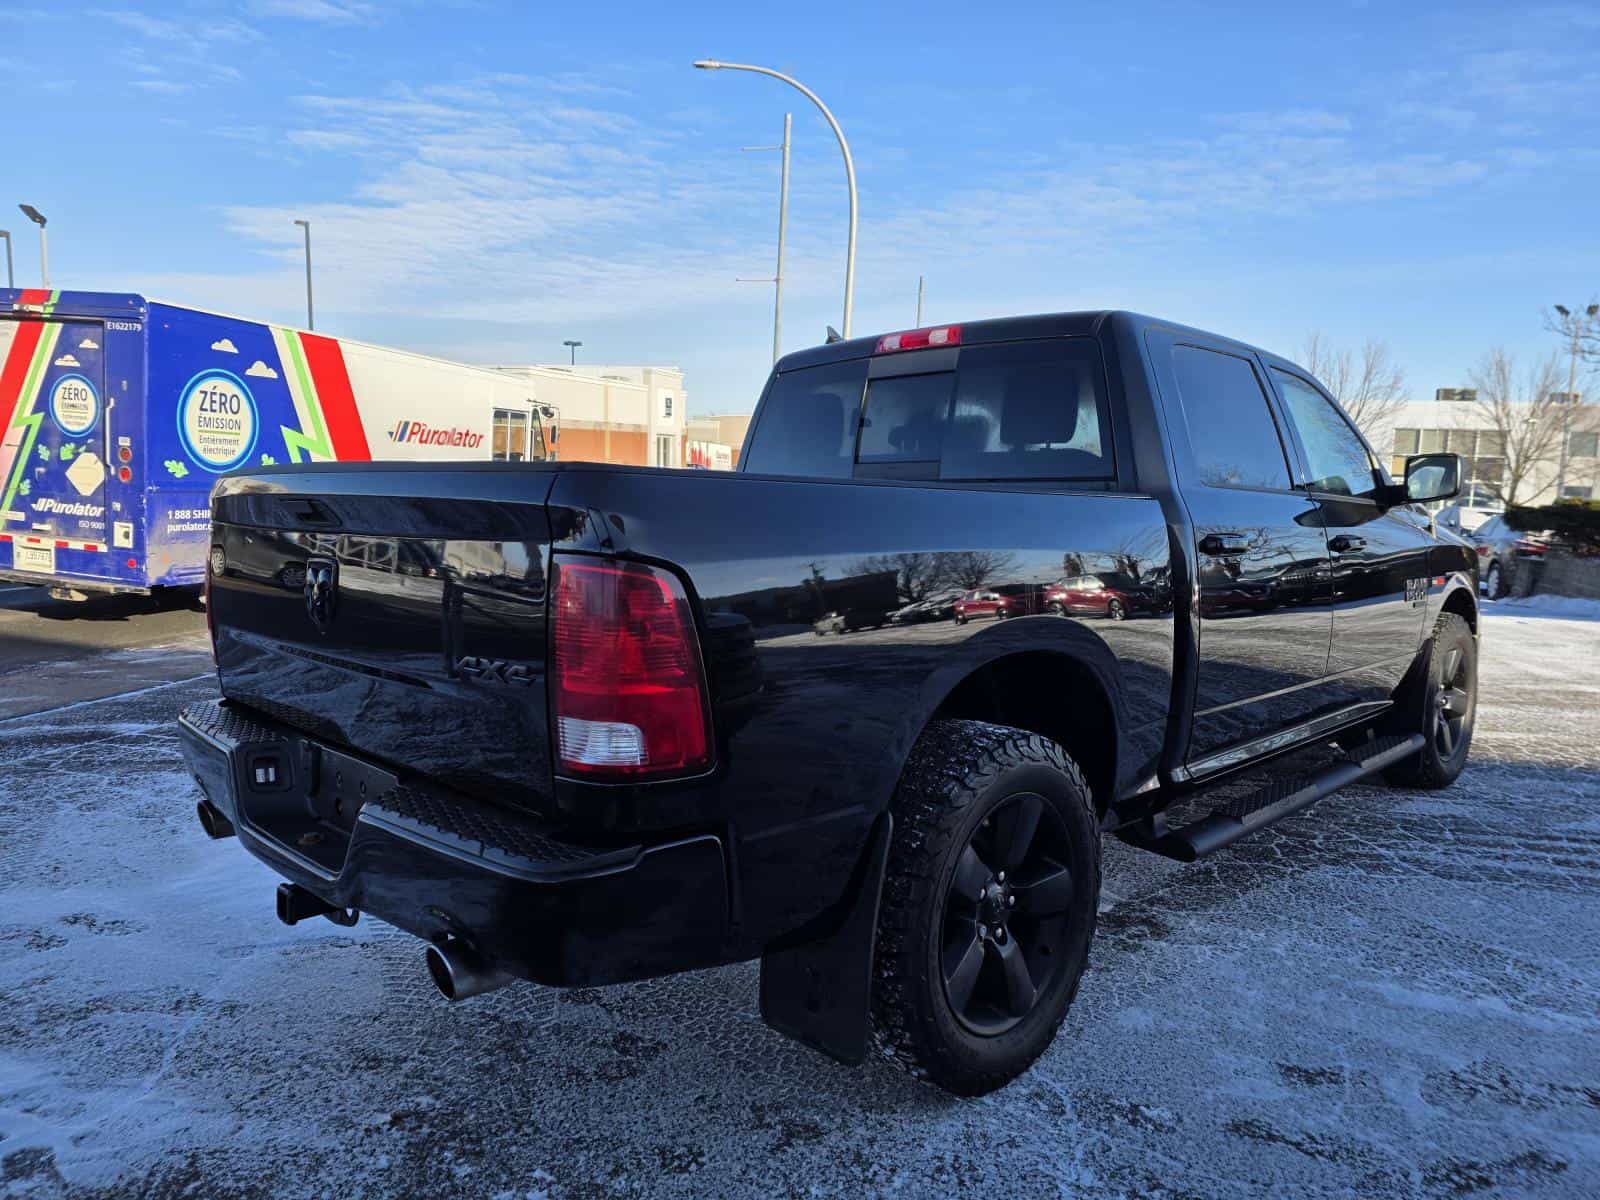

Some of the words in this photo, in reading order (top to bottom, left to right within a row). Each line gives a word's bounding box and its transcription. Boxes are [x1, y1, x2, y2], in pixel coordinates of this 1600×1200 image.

[62, 384, 88, 401] ZÉRO
[199, 385, 241, 415] ZÉRO
[198, 413, 241, 431] ÉMISSION
[199, 435, 239, 446] Entièrement
[406, 421, 484, 448] Purolator
[203, 444, 236, 457] électrique
[44, 498, 104, 517] Purolator
[168, 510, 172, 520] 1
[174, 510, 191, 520] 888
